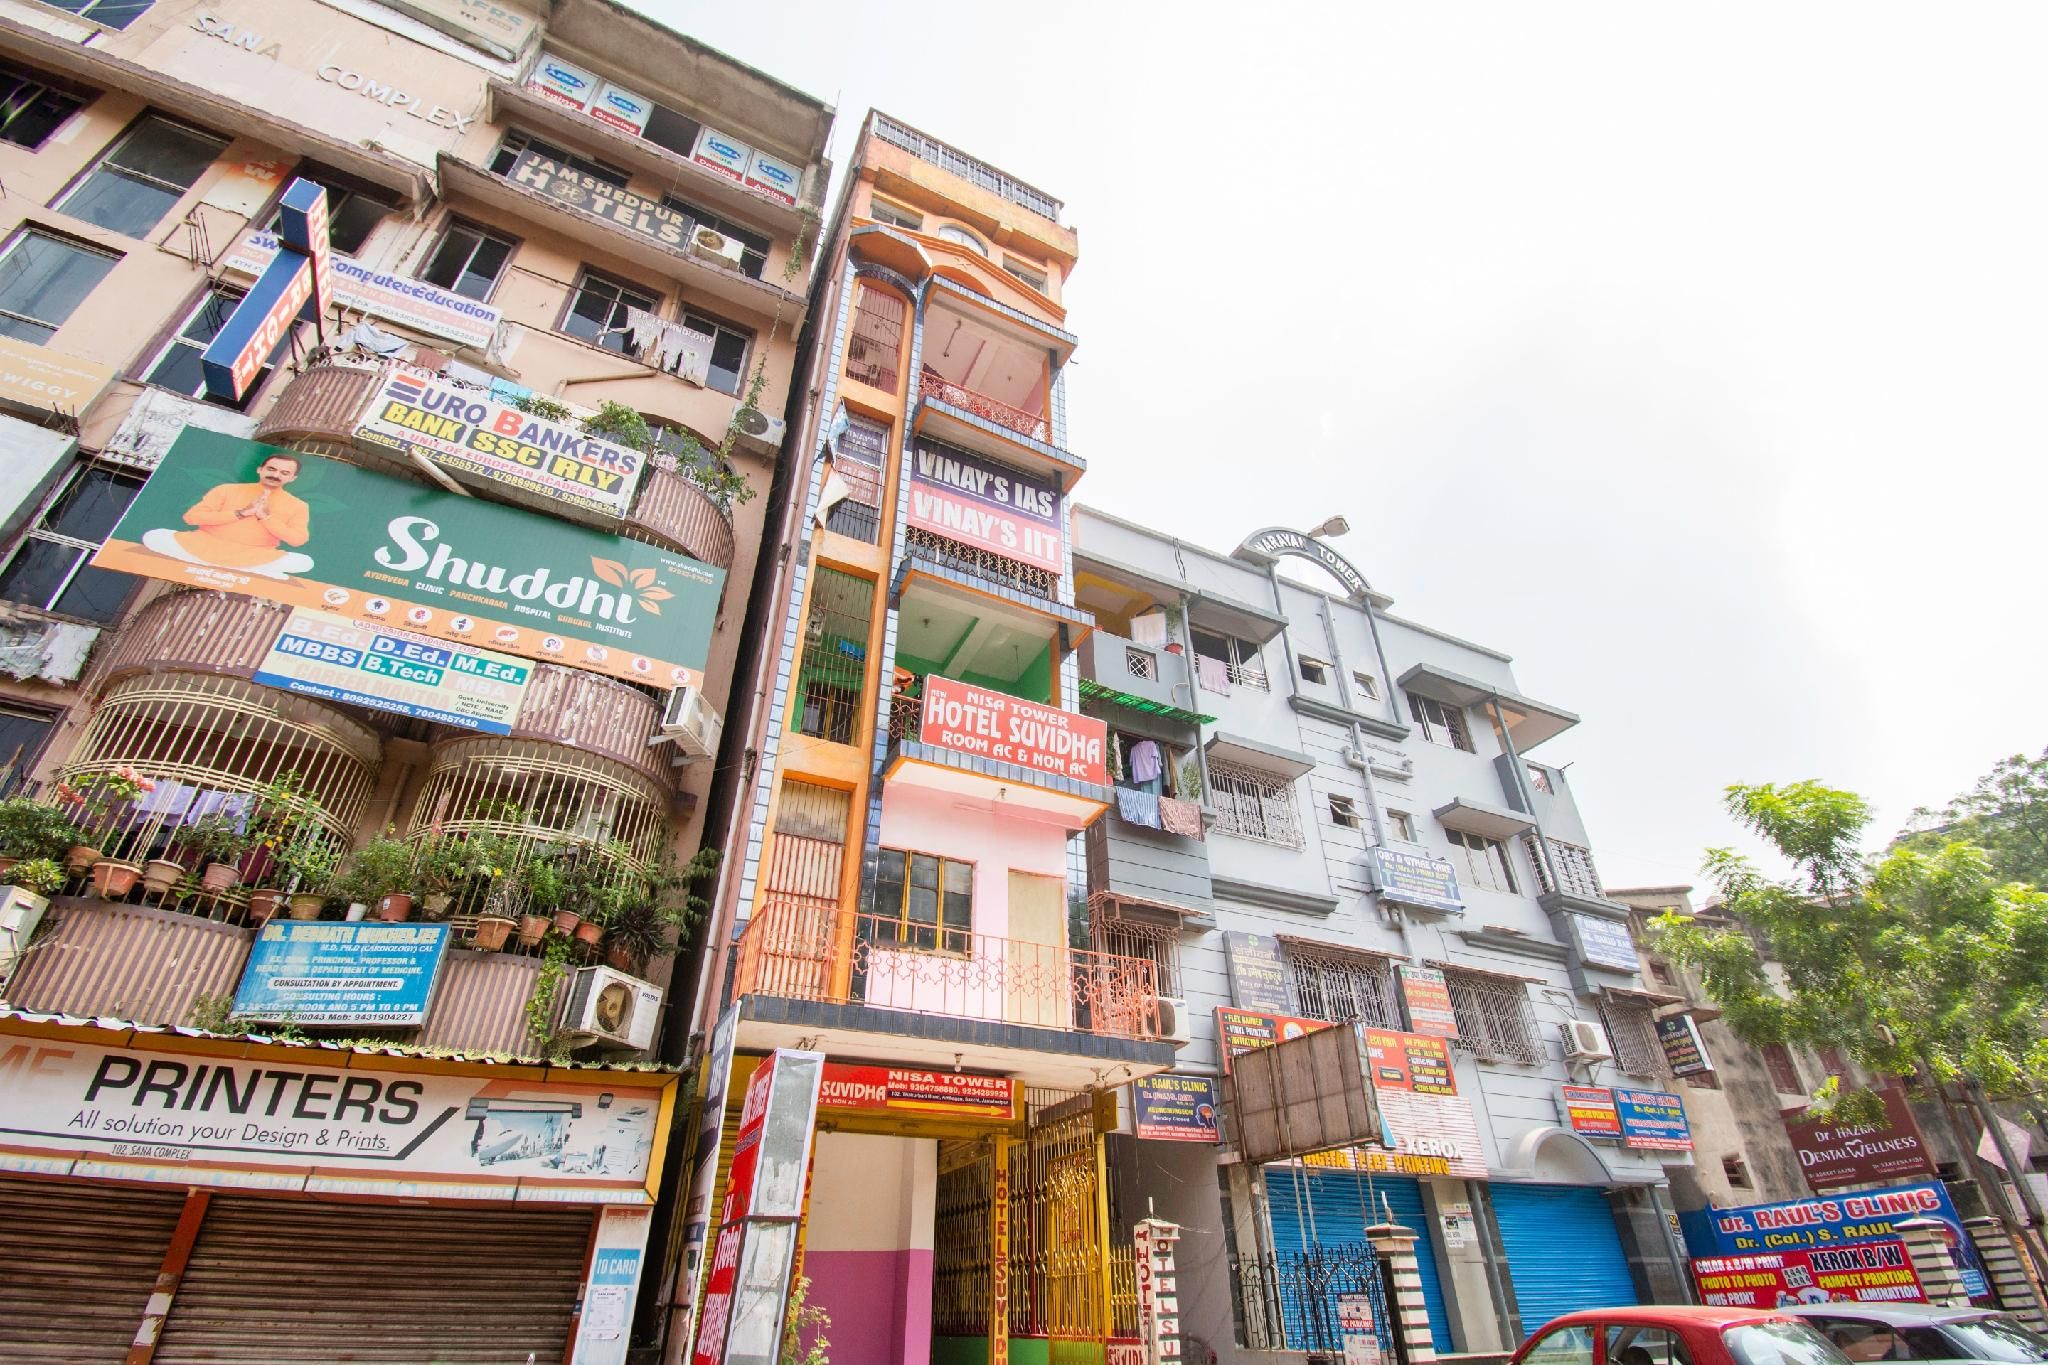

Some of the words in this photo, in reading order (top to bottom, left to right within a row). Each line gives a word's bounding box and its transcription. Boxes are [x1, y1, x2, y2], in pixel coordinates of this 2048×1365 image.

[192, 14, 282, 62] SANA
[317, 63, 475, 135] COMPLEX
[526, 155, 684, 226] JAMSHEDPUR
[412, 284, 497, 323] Education
[0, 370, 78, 399] WIGGY
[383, 402, 465, 443] BANK
[358, 428, 401, 449] Contact
[473, 431, 543, 467] SSC
[494, 409, 637, 475] BANKERS
[409, 433, 442, 450] UNIT
[446, 445, 464, 457] OF
[465, 450, 535, 480] EUROPEAN
[537, 474, 598, 498] ACADEMY
[551, 456, 622, 491] RLY
[918, 448, 1009, 503] VINAY'S
[1014, 482, 1053, 517] IAS
[914, 490, 1017, 549] VINAY'S
[1024, 530, 1058, 561] IIT
[374, 515, 637, 624] Shuddhi
[1317, 545, 1363, 593] TOWER
[363, 570, 409, 587] AYURVEDA
[415, 582, 445, 595] CLINIC
[449, 590, 509, 610] PANCHKARMA
[513, 604, 551, 620] HOSPITAL
[595, 623, 633, 639] INSTITUTE
[289, 617, 365, 647] B.Ed.
[279, 636, 356, 666] MBBS
[373, 636, 446, 666] D.Ed.
[364, 654, 440, 685] B.Tech
[454, 656, 521, 683] M.Ed.
[289, 680, 334, 699] Contact
[456, 676, 506, 700] MBA
[930, 689, 947, 698] NEW
[966, 690, 1005, 712] NISA
[1010, 702, 1069, 730] TOWER
[928, 696, 1002, 739] HOTEL
[1008, 716, 1100, 765] SUVIDHA
[941, 729, 989, 754] ROOM
[992, 743, 1013, 760] AC
[1017, 748, 1028, 763] &
[1032, 752, 1065, 773] NON
[1069, 761, 1088, 777] AC
[262, 925, 287, 942] DR.
[311, 965, 367, 975] DEPARTMENT
[360, 956, 411, 966] PROFESSOR
[273, 979, 330, 988] CONSULTATION
[282, 992, 342, 1001] COSULTING
[343, 992, 376, 1001] HOURS
[354, 1012, 414, 1022] 9431904227
[1228, 1014, 1241, 1024] FLEX
[84, 1054, 423, 1125] PRINTERS
[822, 1081, 887, 1102] SUVIDHA
[888, 1070, 936, 1084] NISA
[940, 1074, 1007, 1090] TOWER
[1151, 1078, 1180, 1091] RAUL'S
[1181, 1080, 1208, 1093] CLINIC
[68, 1110, 100, 1128] All
[102, 1113, 184, 1137] solution
[187, 1122, 236, 1142] your
[241, 1122, 309, 1147] Design
[315, 1128, 330, 1145] &
[336, 1128, 390, 1151] Prints.
[1814, 1131, 1835, 1142] Dr.
[129, 1145, 152, 1157] SANA
[153, 1146, 192, 1160] COMPLEX
[1403, 1136, 1463, 1159] XEROX
[1799, 1149, 1850, 1167] DENTAL
[1846, 1136, 1918, 1158] WELLNESS
[1358, 1153, 1388, 1171] FLEX
[1394, 1154, 1450, 1176] PRINTING
[996, 1168, 1007, 1258] HOTEL
[1718, 1216, 1753, 1234] Dr.
[1753, 1200, 1842, 1231] RAUL'S
[1843, 1187, 1942, 1219] CLINIC
[1735, 1237, 1760, 1250] Dr.
[1765, 1230, 1815, 1249] (Col.)
[1818, 1229, 1839, 1242] S.
[1842, 1222, 1897, 1240] RAUL
[609, 1258, 637, 1275] CARD
[1696, 1260, 1726, 1274] COLOR
[1756, 1255, 1785, 1270] PRINT
[1809, 1250, 1864, 1272] XEROX
[1864, 1245, 1905, 1268] B/W
[1701, 1274, 1730, 1289] PHOTO
[1731, 1274, 1743, 1288] TO
[1744, 1272, 1777, 1287] PHOTO
[1817, 1273, 1864, 1289] PAMPLET
[1863, 1269, 1915, 1287] PRINTING
[1705, 1293, 1726, 1306] MUG
[1727, 1291, 1755, 1306] PRINT
[1855, 1285, 1921, 1302] LAMINATION
